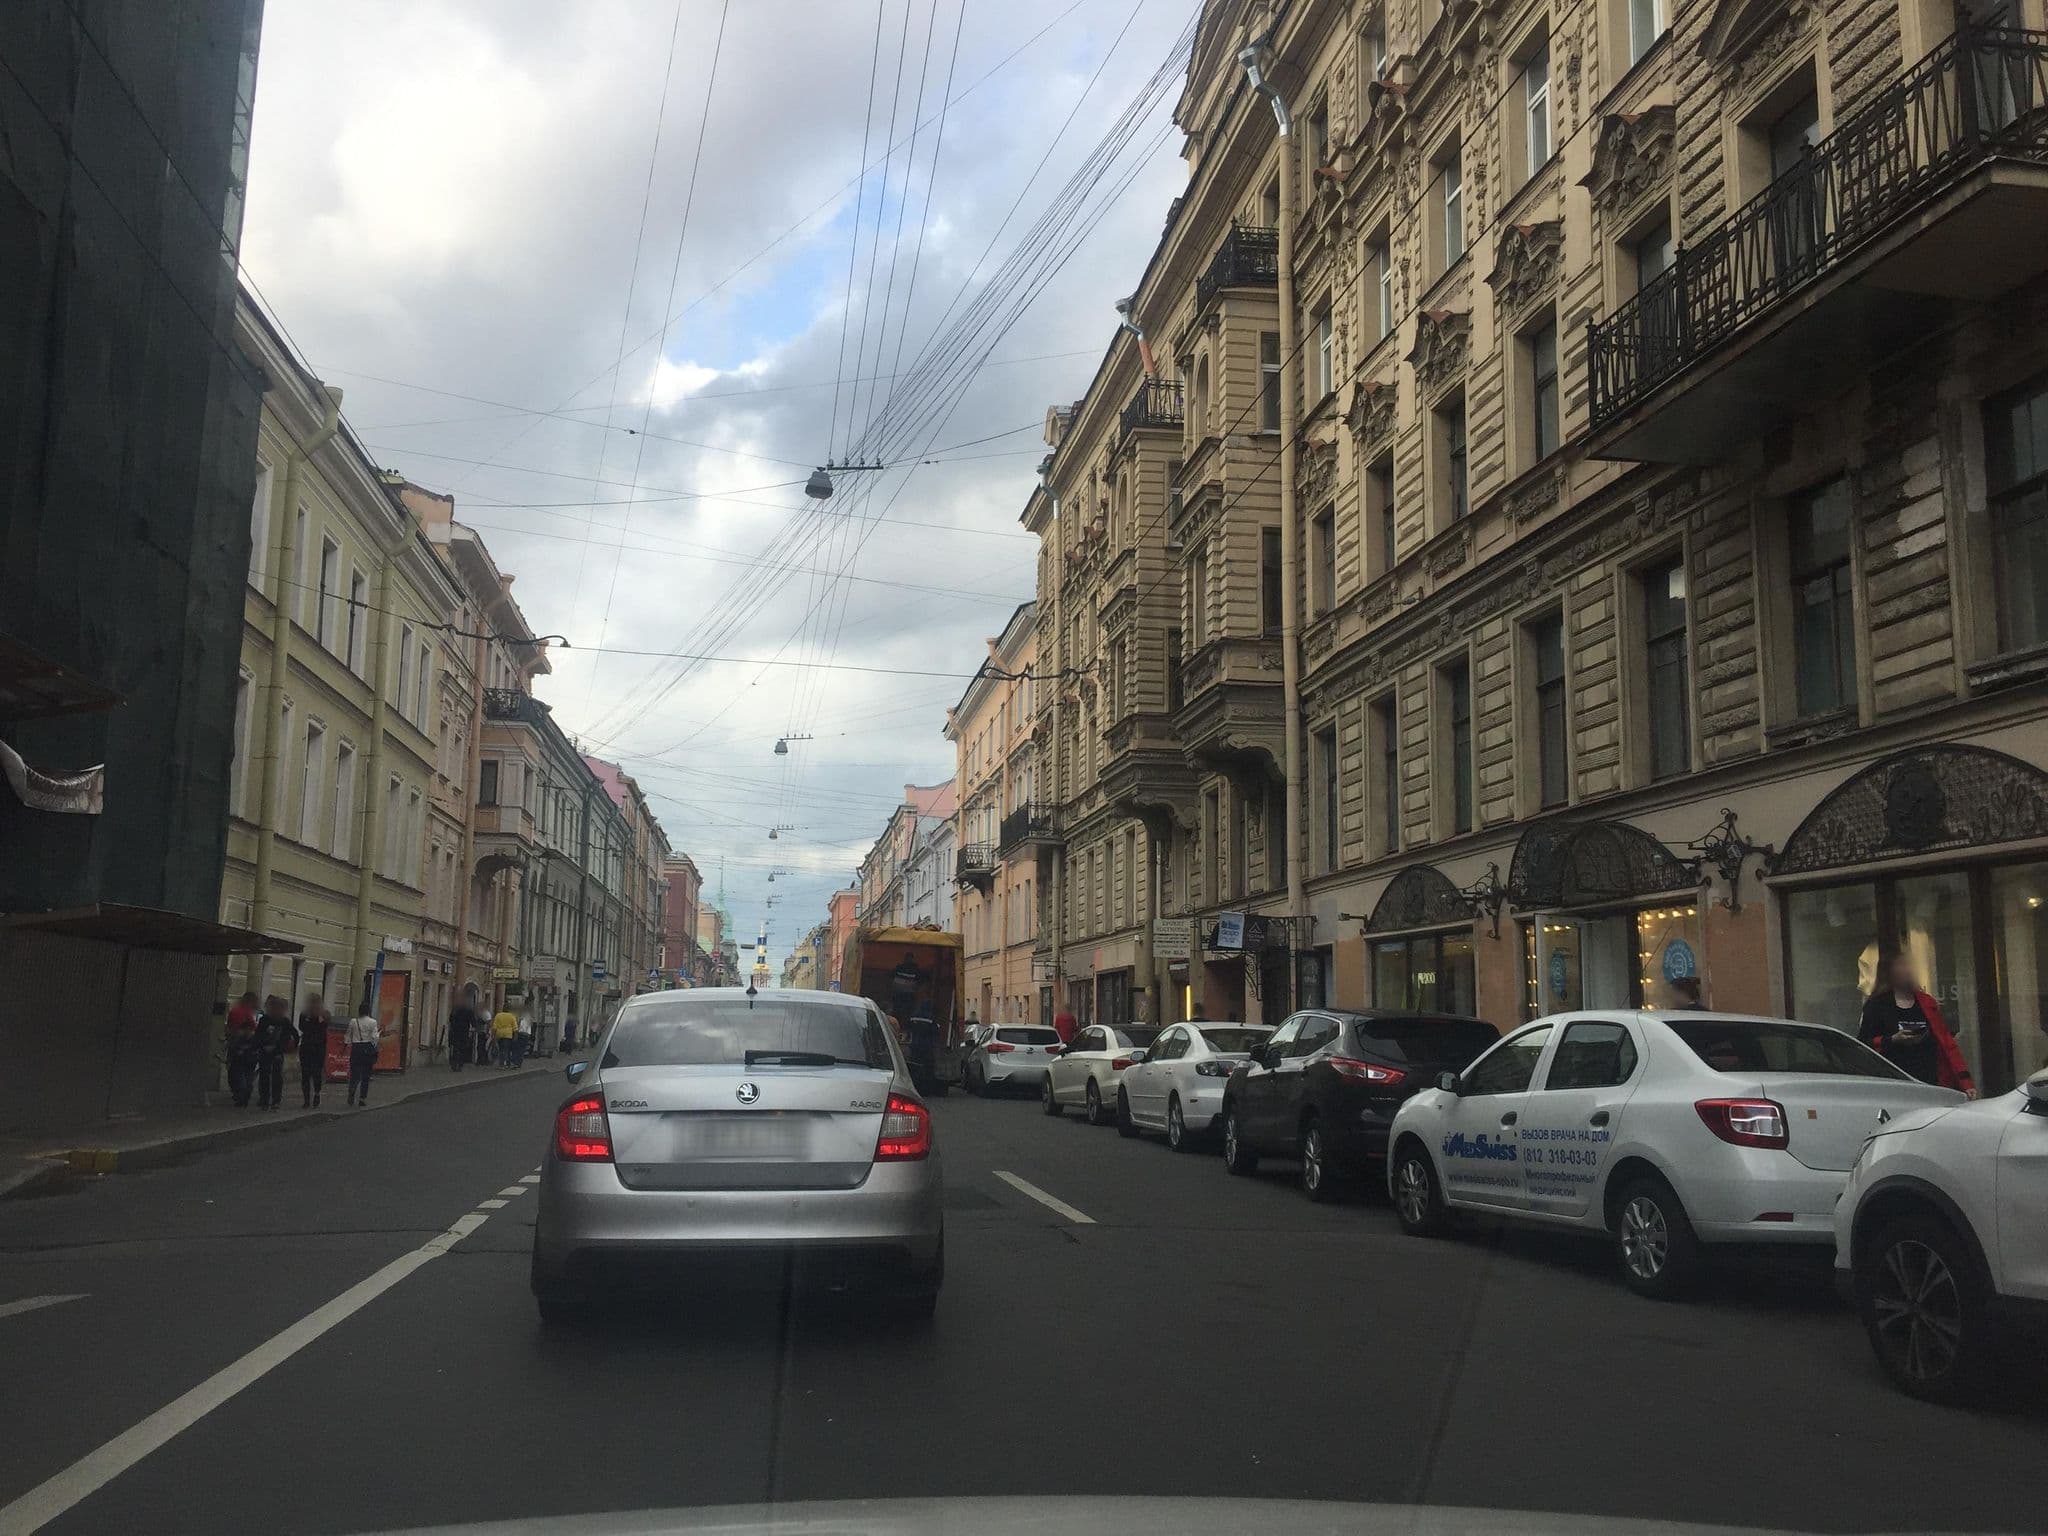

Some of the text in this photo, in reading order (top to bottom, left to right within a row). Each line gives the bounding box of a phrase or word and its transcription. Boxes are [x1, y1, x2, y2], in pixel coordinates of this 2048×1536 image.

[850, 1100, 882, 1109] RAPID
[1521, 1129, 1610, 1143] ВЫЗОВ ВРАЧА НА ДОМ
[1548, 1148, 1597, 1166] 318-03-03
